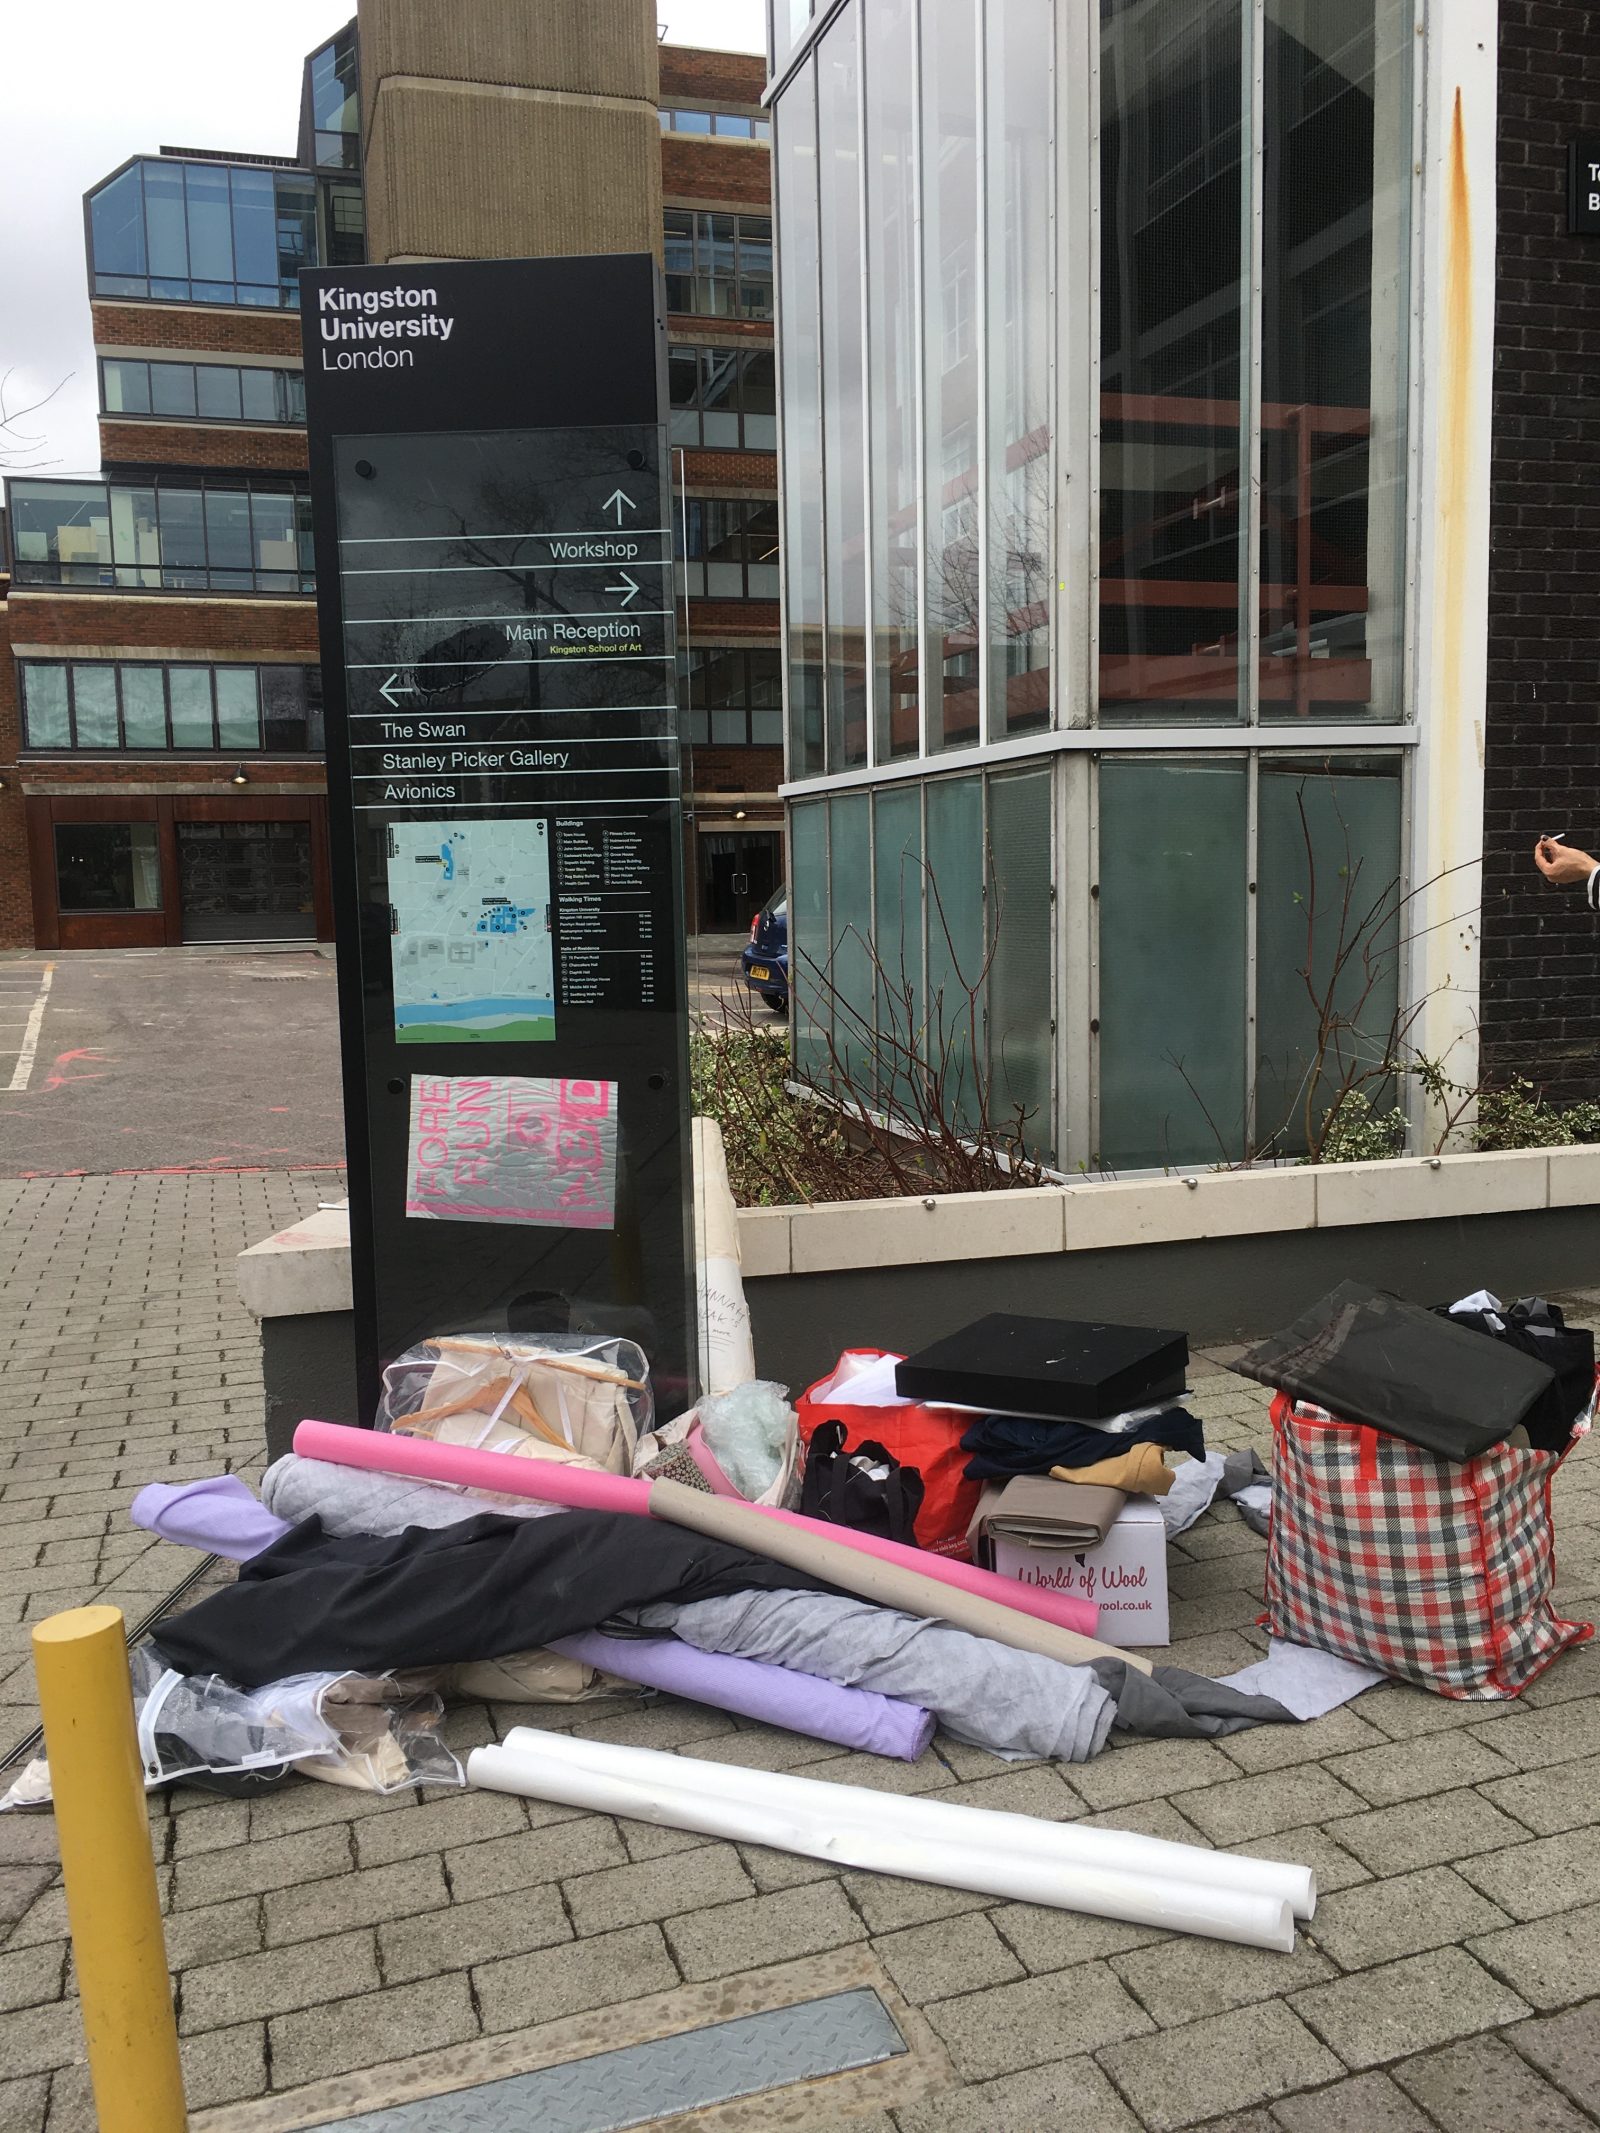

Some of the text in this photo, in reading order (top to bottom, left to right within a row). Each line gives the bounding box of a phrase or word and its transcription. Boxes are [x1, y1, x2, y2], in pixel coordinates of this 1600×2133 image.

[318, 285, 437, 314] Kingston
[320, 314, 454, 342] University
[322, 345, 414, 371] London
[550, 541, 638, 559] Workshop
[506, 621, 641, 642] Main Reception
[550, 642, 642, 655] Kingston School of Art
[381, 721, 466, 738] The Swan
[383, 749, 569, 772] Stanley Picker Gallery
[384, 783, 456, 800] Avionics
[556, 820, 584, 828] Buildings
[1018, 1565, 1147, 1598] World of Wool
